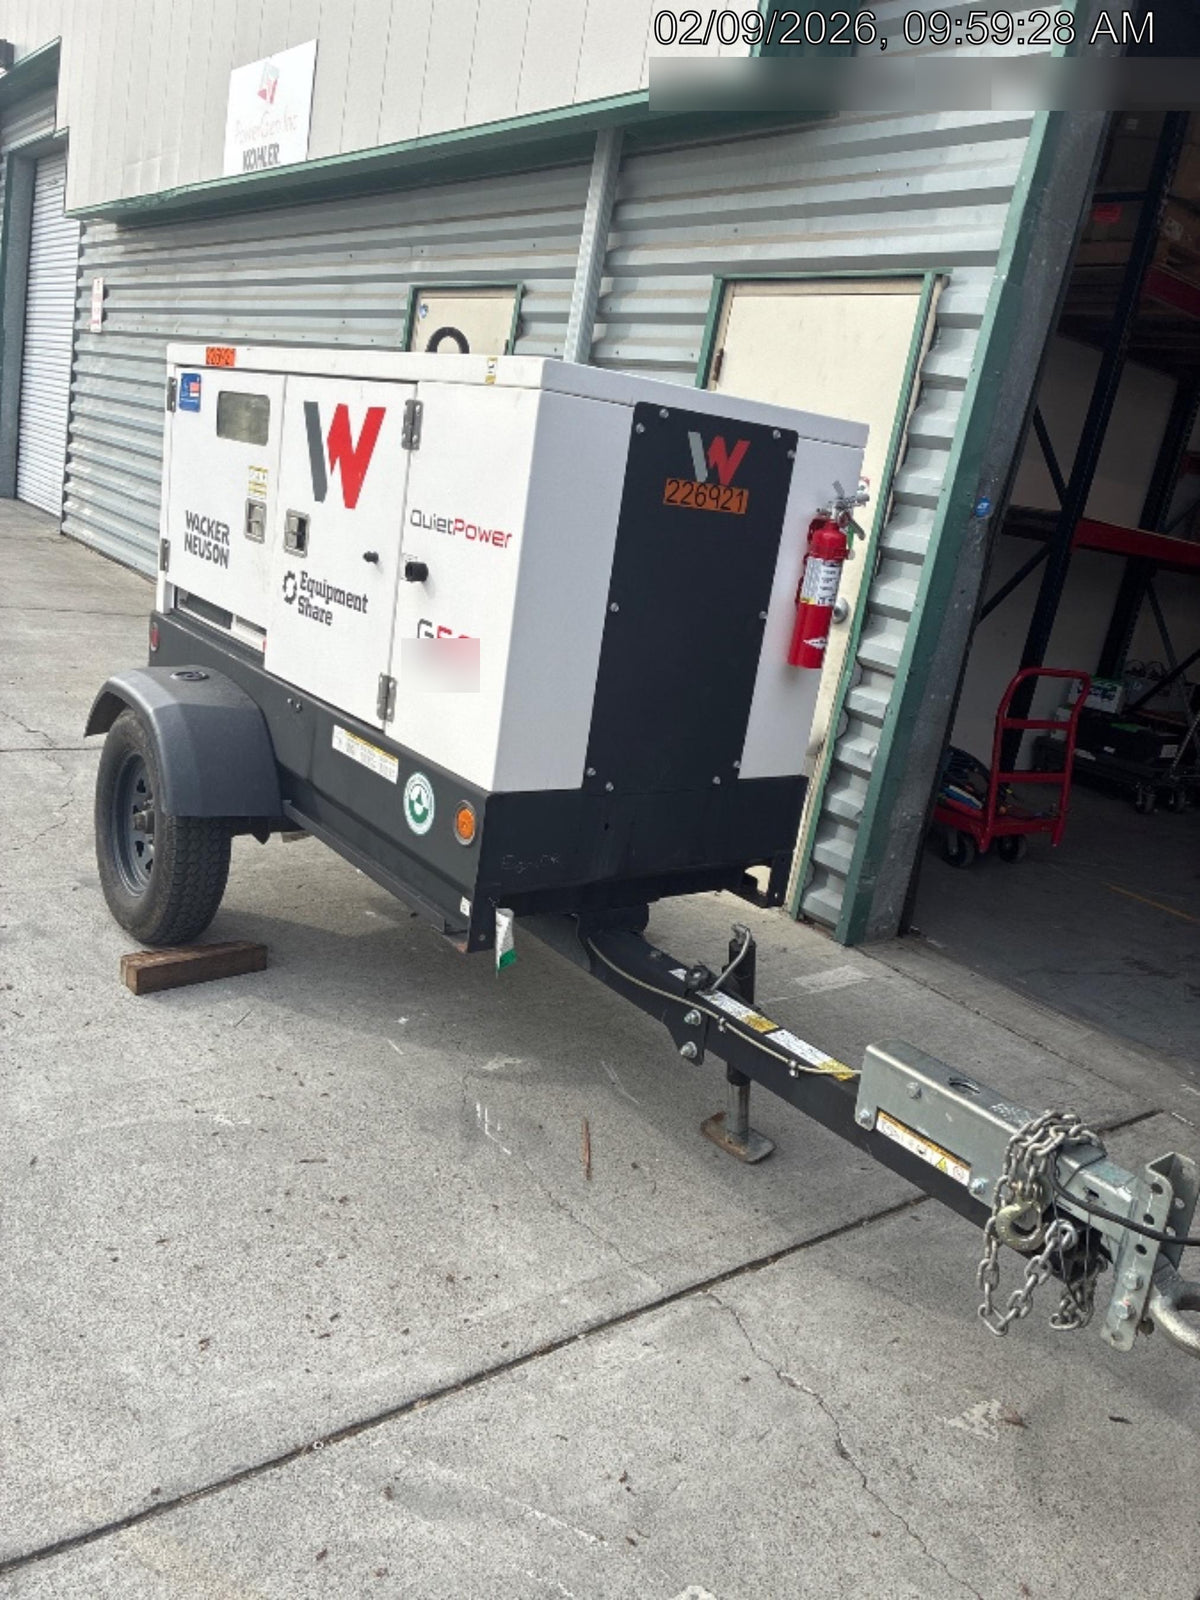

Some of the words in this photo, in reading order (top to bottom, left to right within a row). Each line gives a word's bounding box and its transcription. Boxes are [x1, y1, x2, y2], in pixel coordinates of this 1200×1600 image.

[666, 479, 745, 513] 226921
[185, 509, 230, 546] WACKER
[410, 509, 513, 549] QuietPower
[184, 532, 230, 569] NEUSON
[298, 595, 333, 626] Share
[300, 570, 368, 614] Equipment
